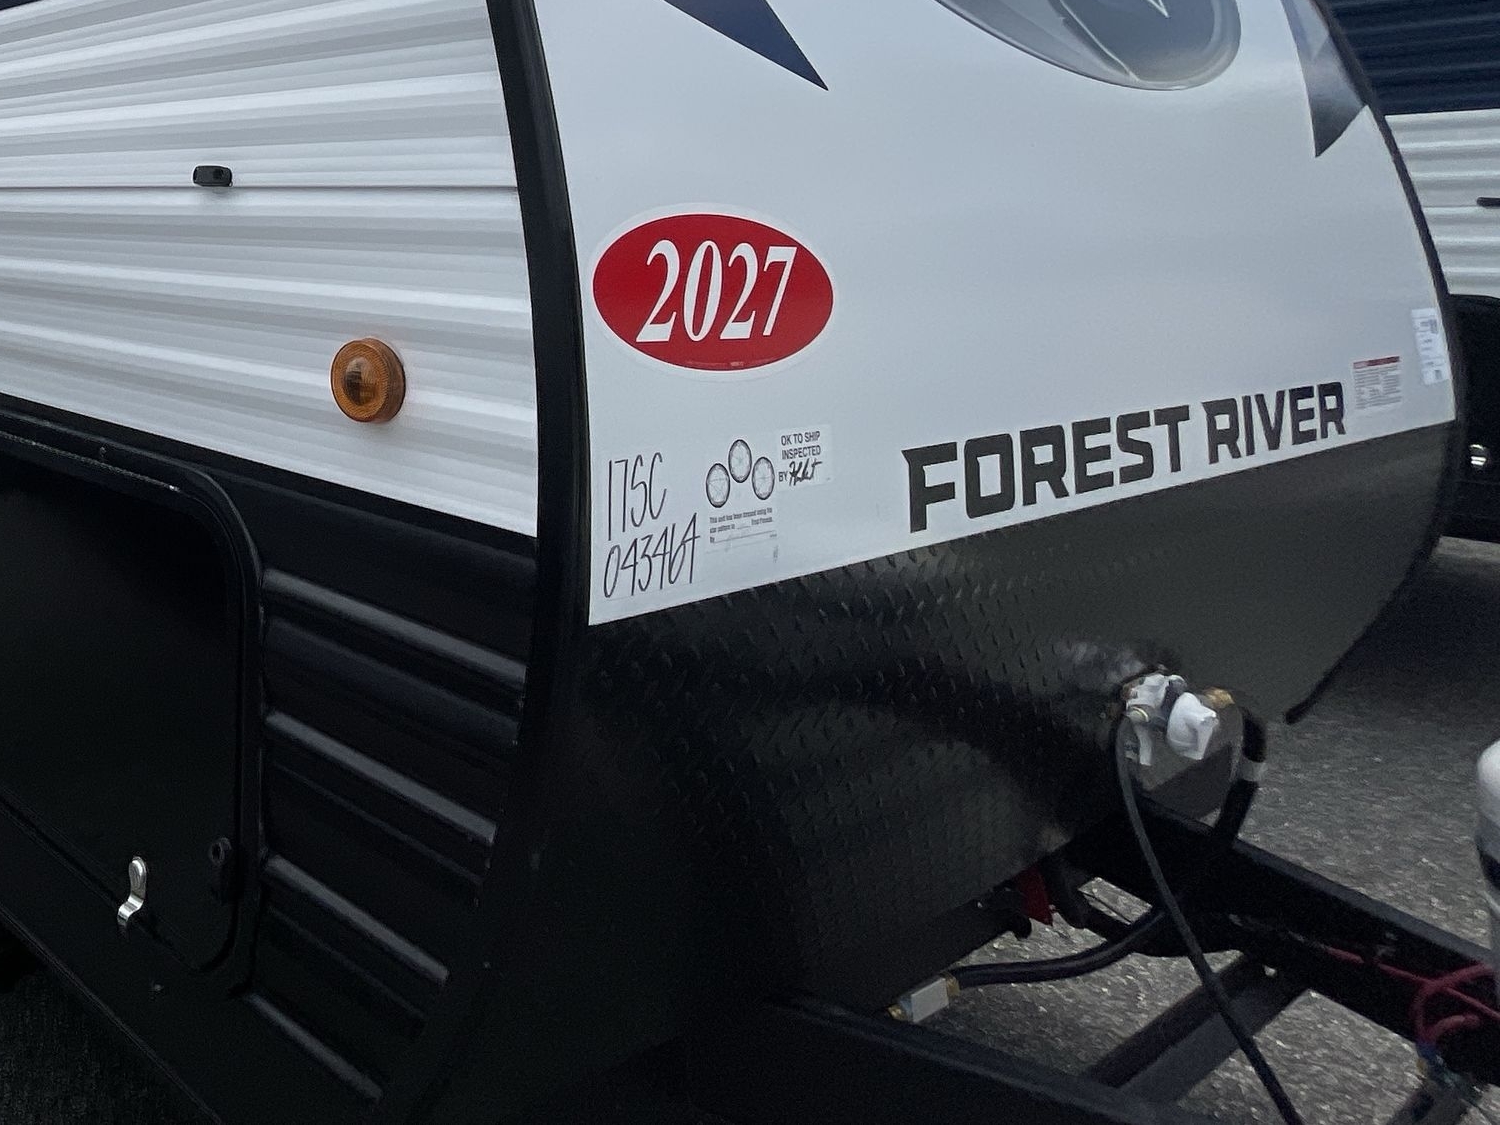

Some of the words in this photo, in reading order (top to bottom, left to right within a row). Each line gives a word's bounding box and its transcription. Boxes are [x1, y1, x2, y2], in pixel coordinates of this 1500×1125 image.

[635, 239, 798, 343] 2027
[781, 435, 792, 446] OK
[794, 433, 803, 444] TO
[805, 431, 820, 443] SHIP
[782, 445, 821, 460] INSPECTED
[901, 404, 1191, 533] FOREST
[1201, 381, 1347, 465] RIVER
[778, 471, 788, 482] BY
